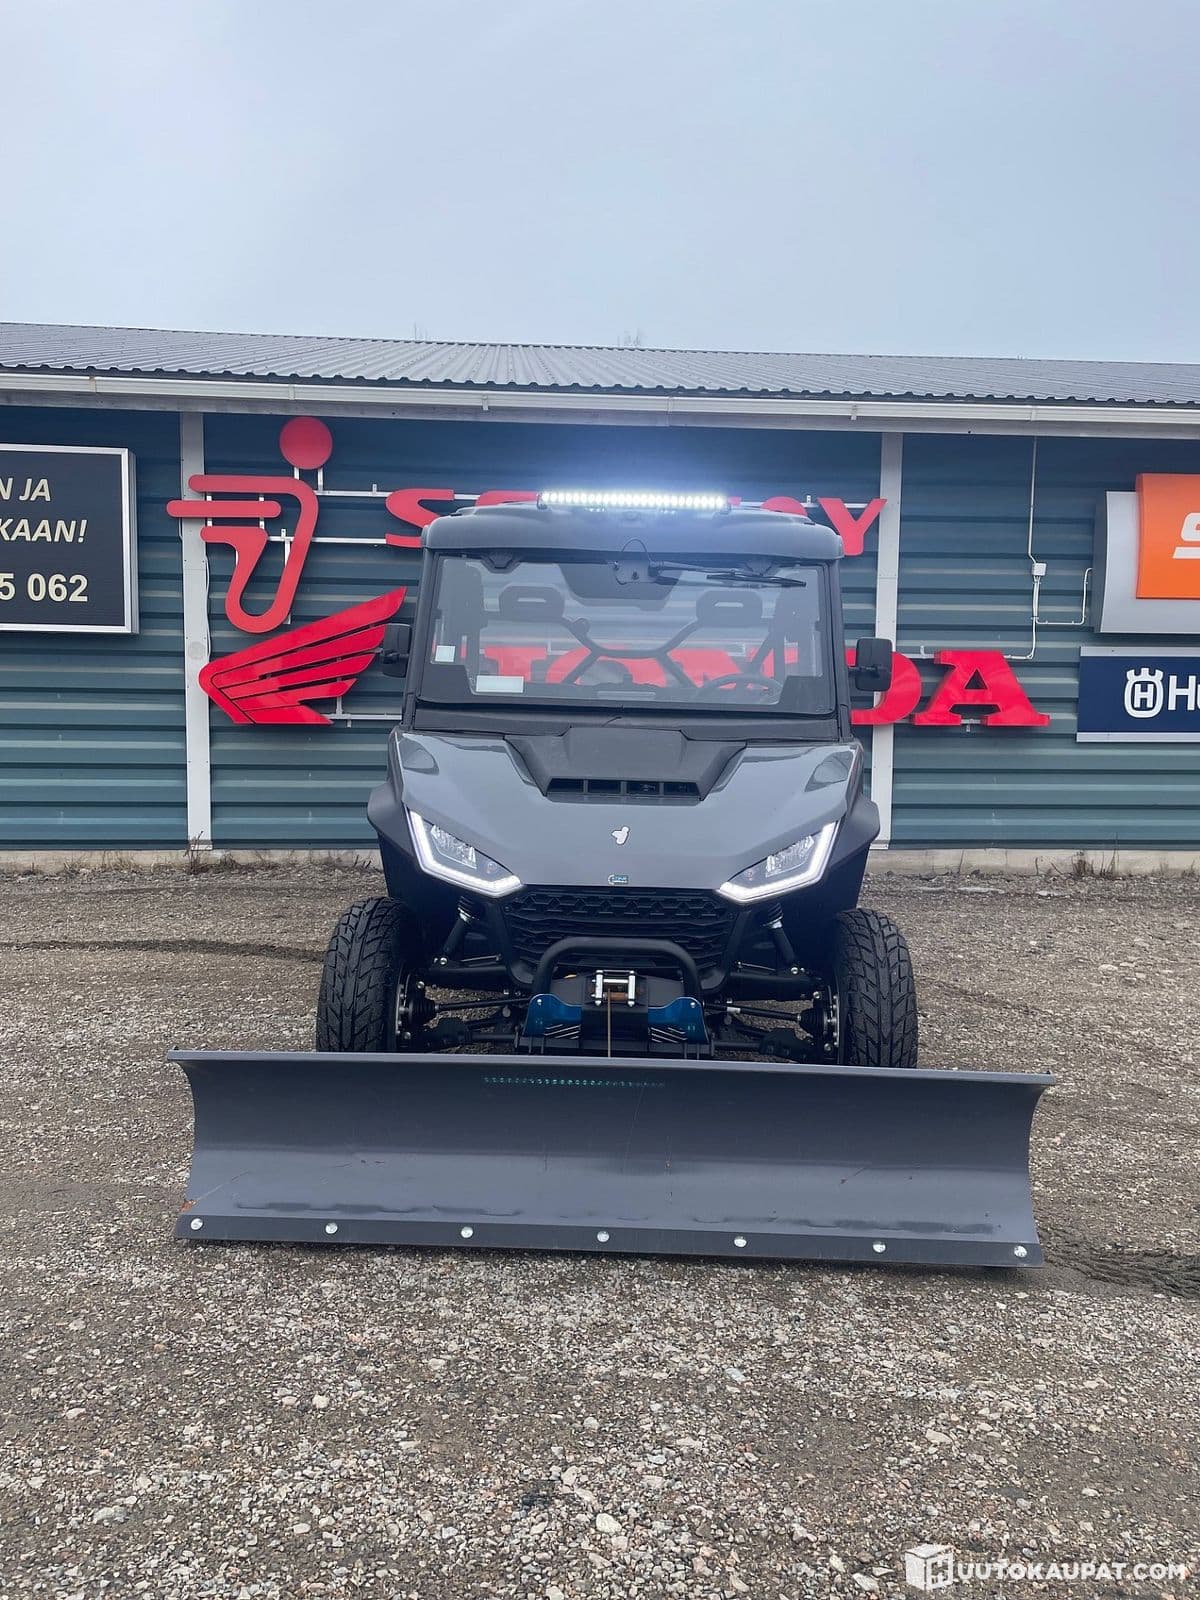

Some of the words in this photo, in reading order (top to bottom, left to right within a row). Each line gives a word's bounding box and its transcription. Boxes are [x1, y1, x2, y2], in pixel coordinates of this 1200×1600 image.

[19, 479, 51, 501] JA
[0, 573, 16, 600] 5
[27, 573, 88, 602] 062
[1168, 675, 1200, 711] H
